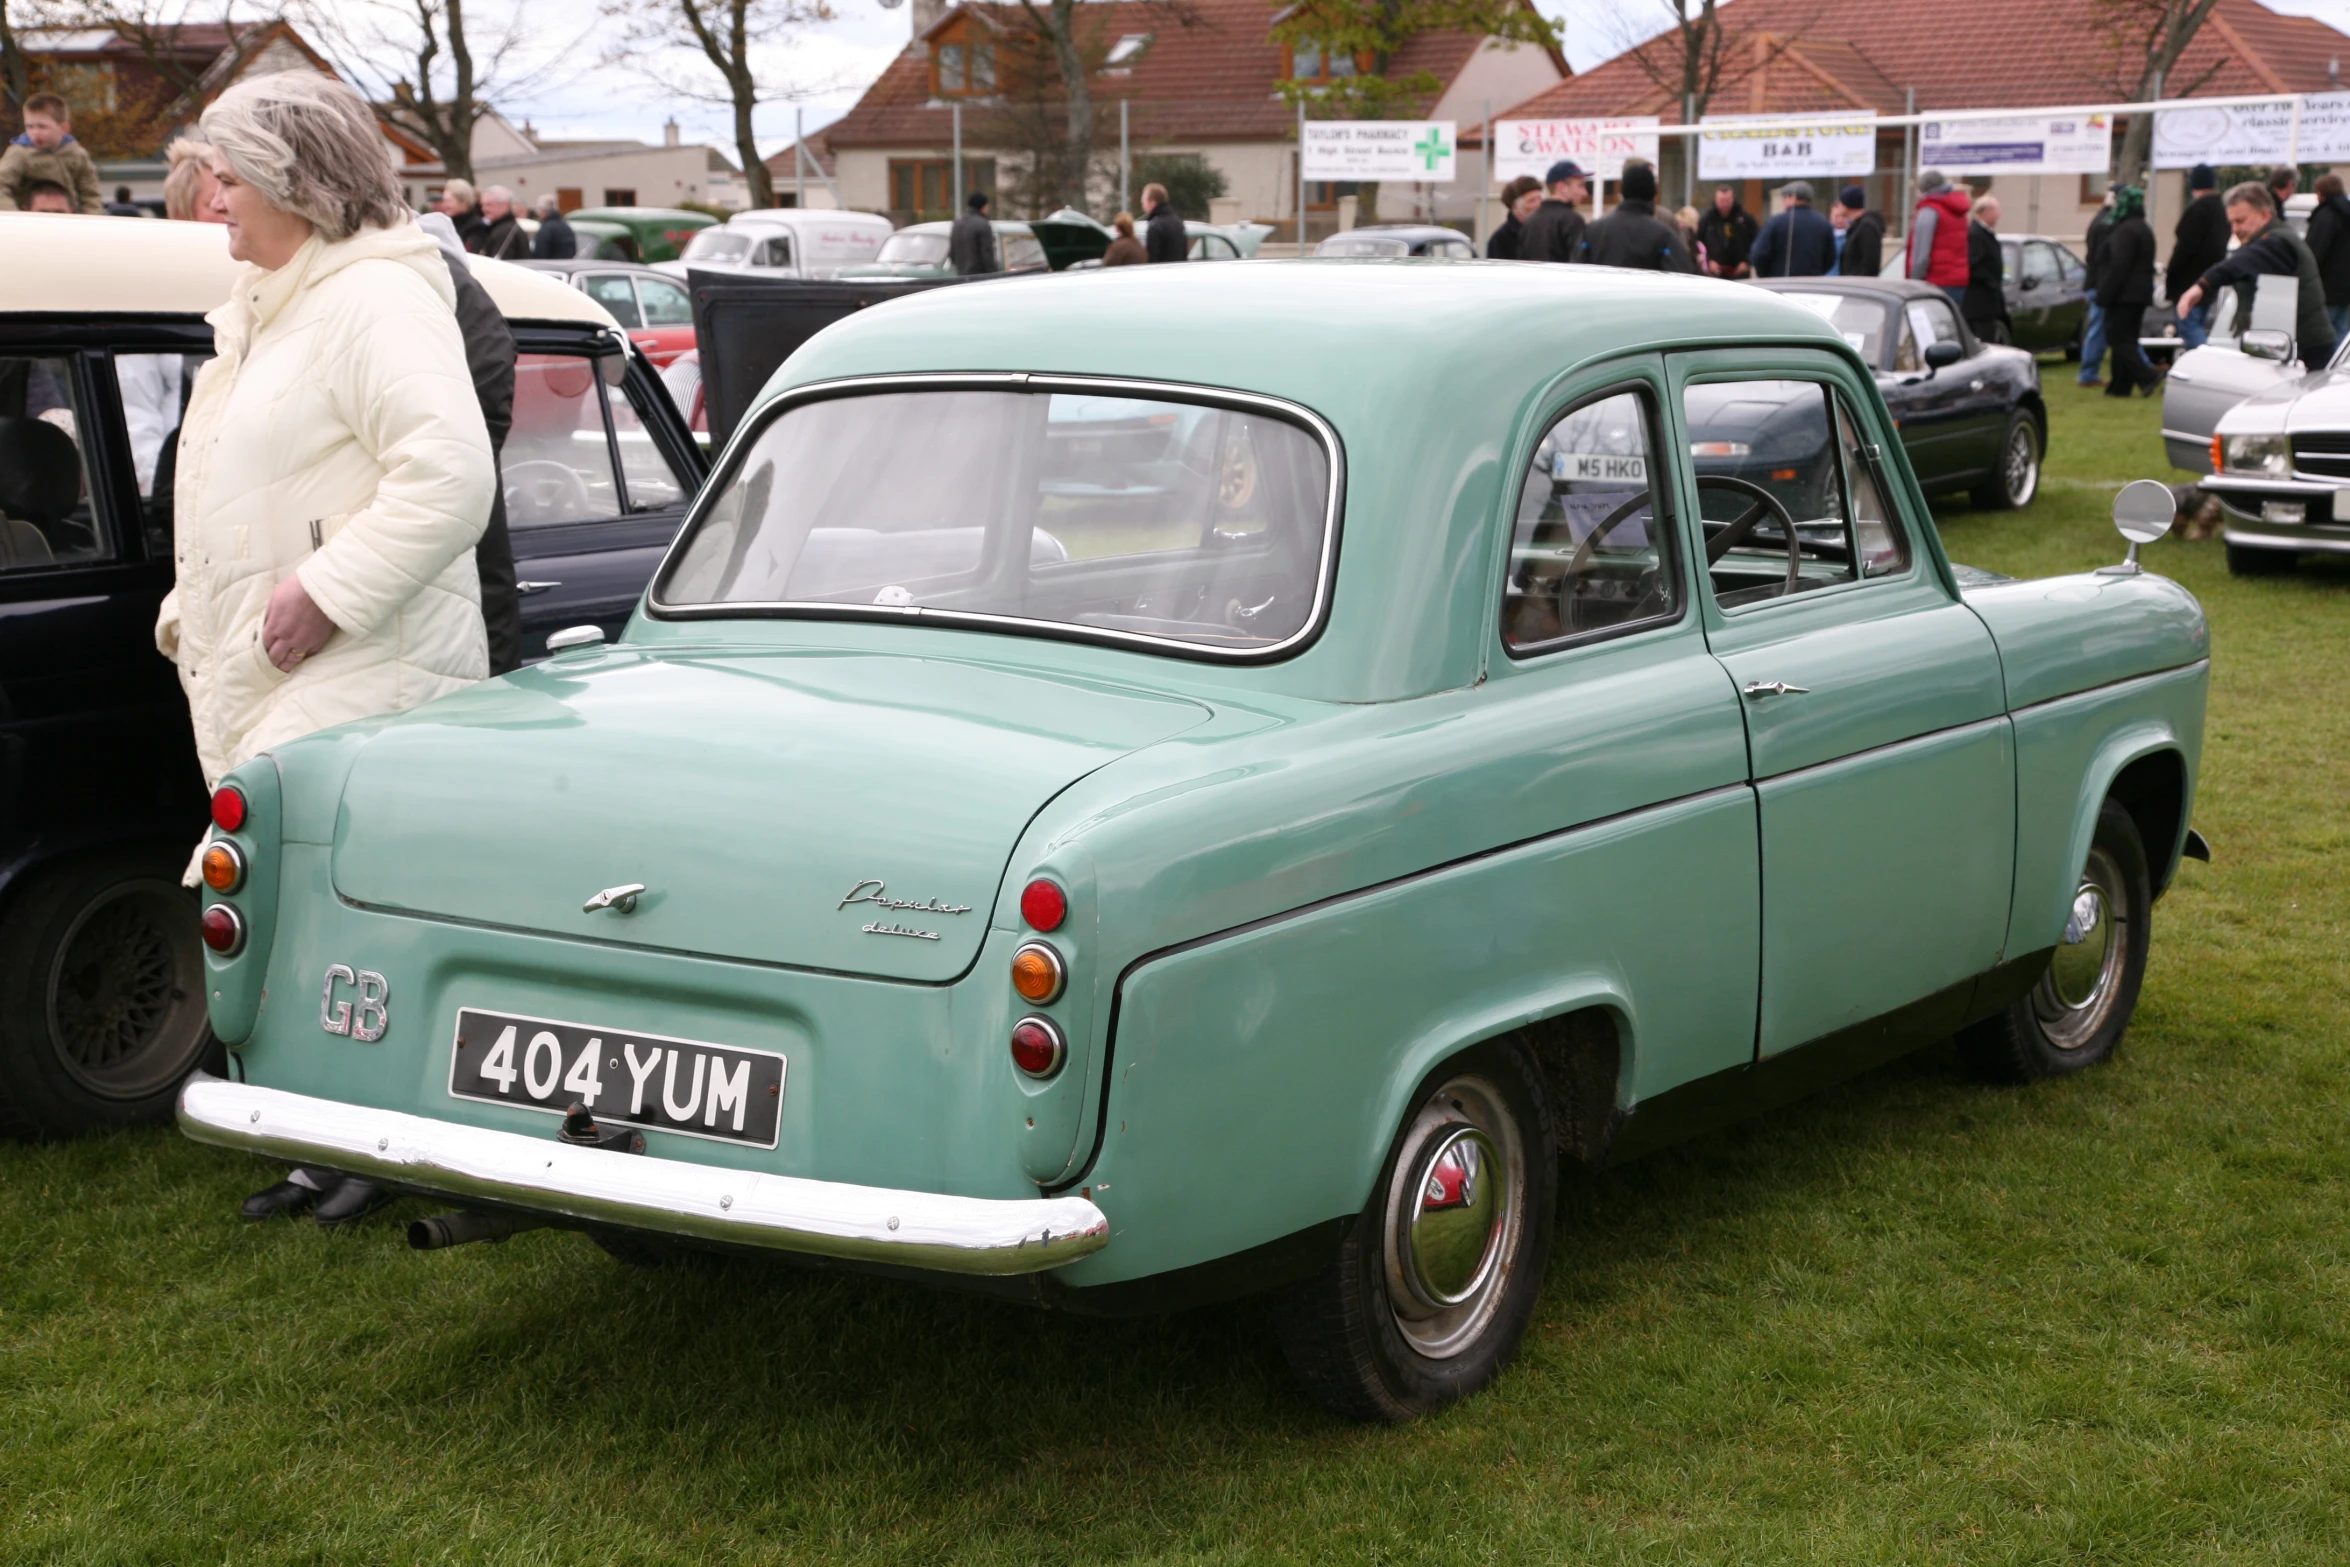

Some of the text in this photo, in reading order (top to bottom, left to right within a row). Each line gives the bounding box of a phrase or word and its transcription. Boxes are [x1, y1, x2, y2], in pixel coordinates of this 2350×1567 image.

[2242, 114, 2290, 128] classic
[1356, 128, 1409, 140] PHARMACY
[1344, 145, 1372, 155] Street
[1535, 136, 1637, 154] WATSON
[1578, 458, 1601, 477] M5
[837, 879, 972, 915] Popular
[861, 921, 941, 941] deluxe
[320, 963, 389, 1042] GB
[480, 1025, 751, 1132] 404 YUM
